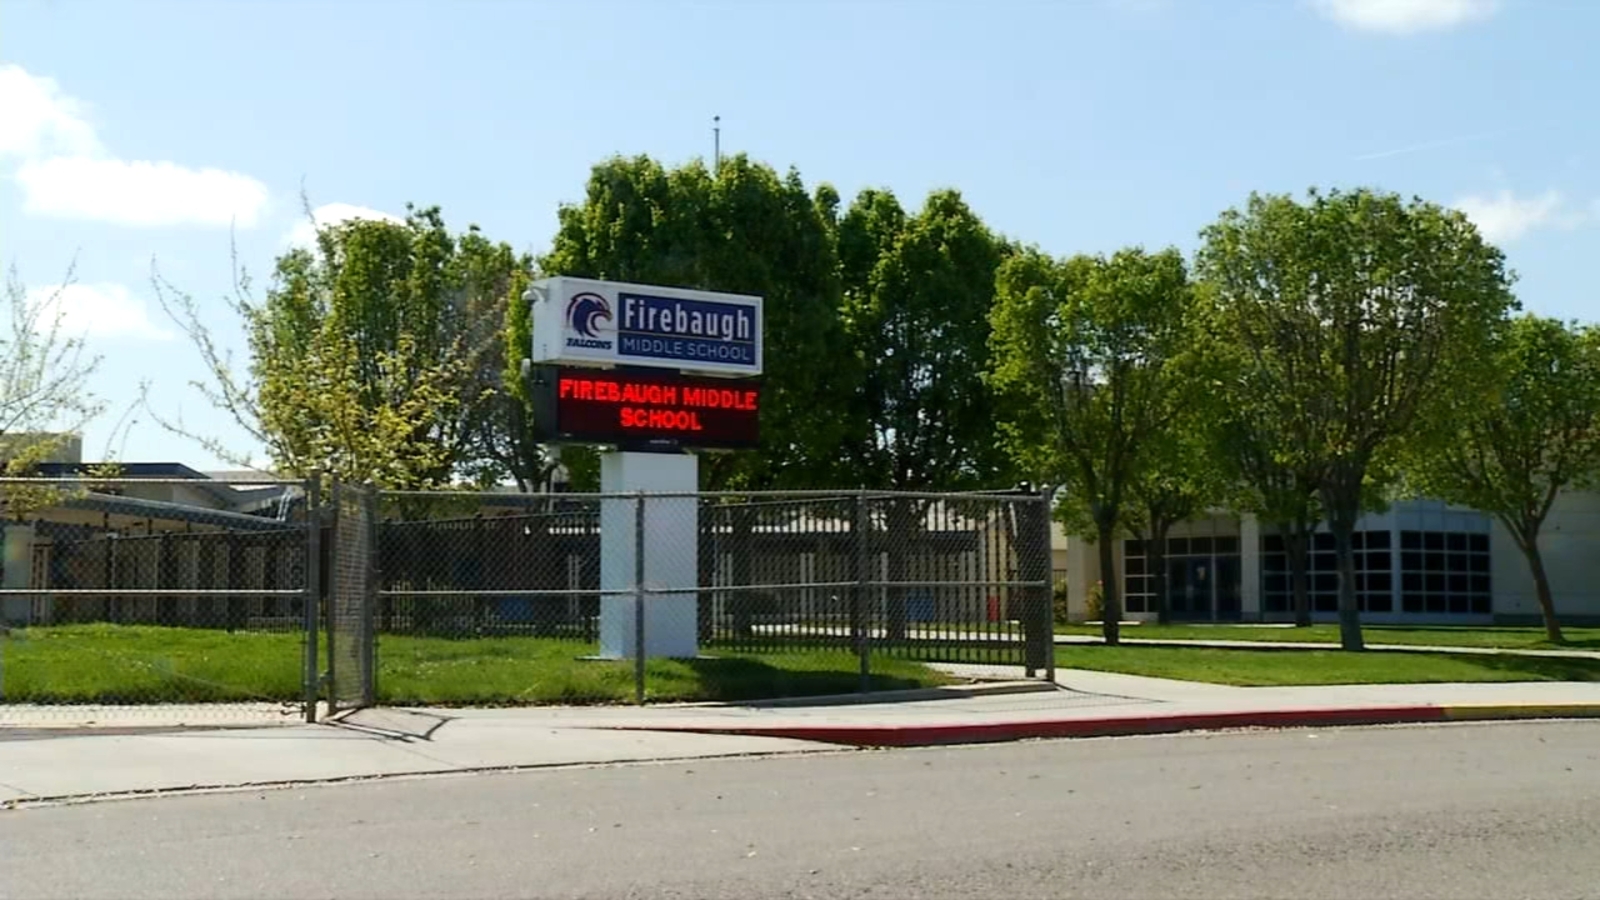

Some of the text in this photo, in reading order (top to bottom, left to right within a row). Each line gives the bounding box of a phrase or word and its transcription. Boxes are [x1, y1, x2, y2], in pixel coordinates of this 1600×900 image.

[624, 298, 749, 342] Firebaugh
[566, 337, 612, 350] FALCONS
[622, 338, 750, 361] MIDDLE SCHOOL
[559, 379, 758, 410] FIREBAUGH MIDDLE
[620, 407, 702, 430] SCHOOL
